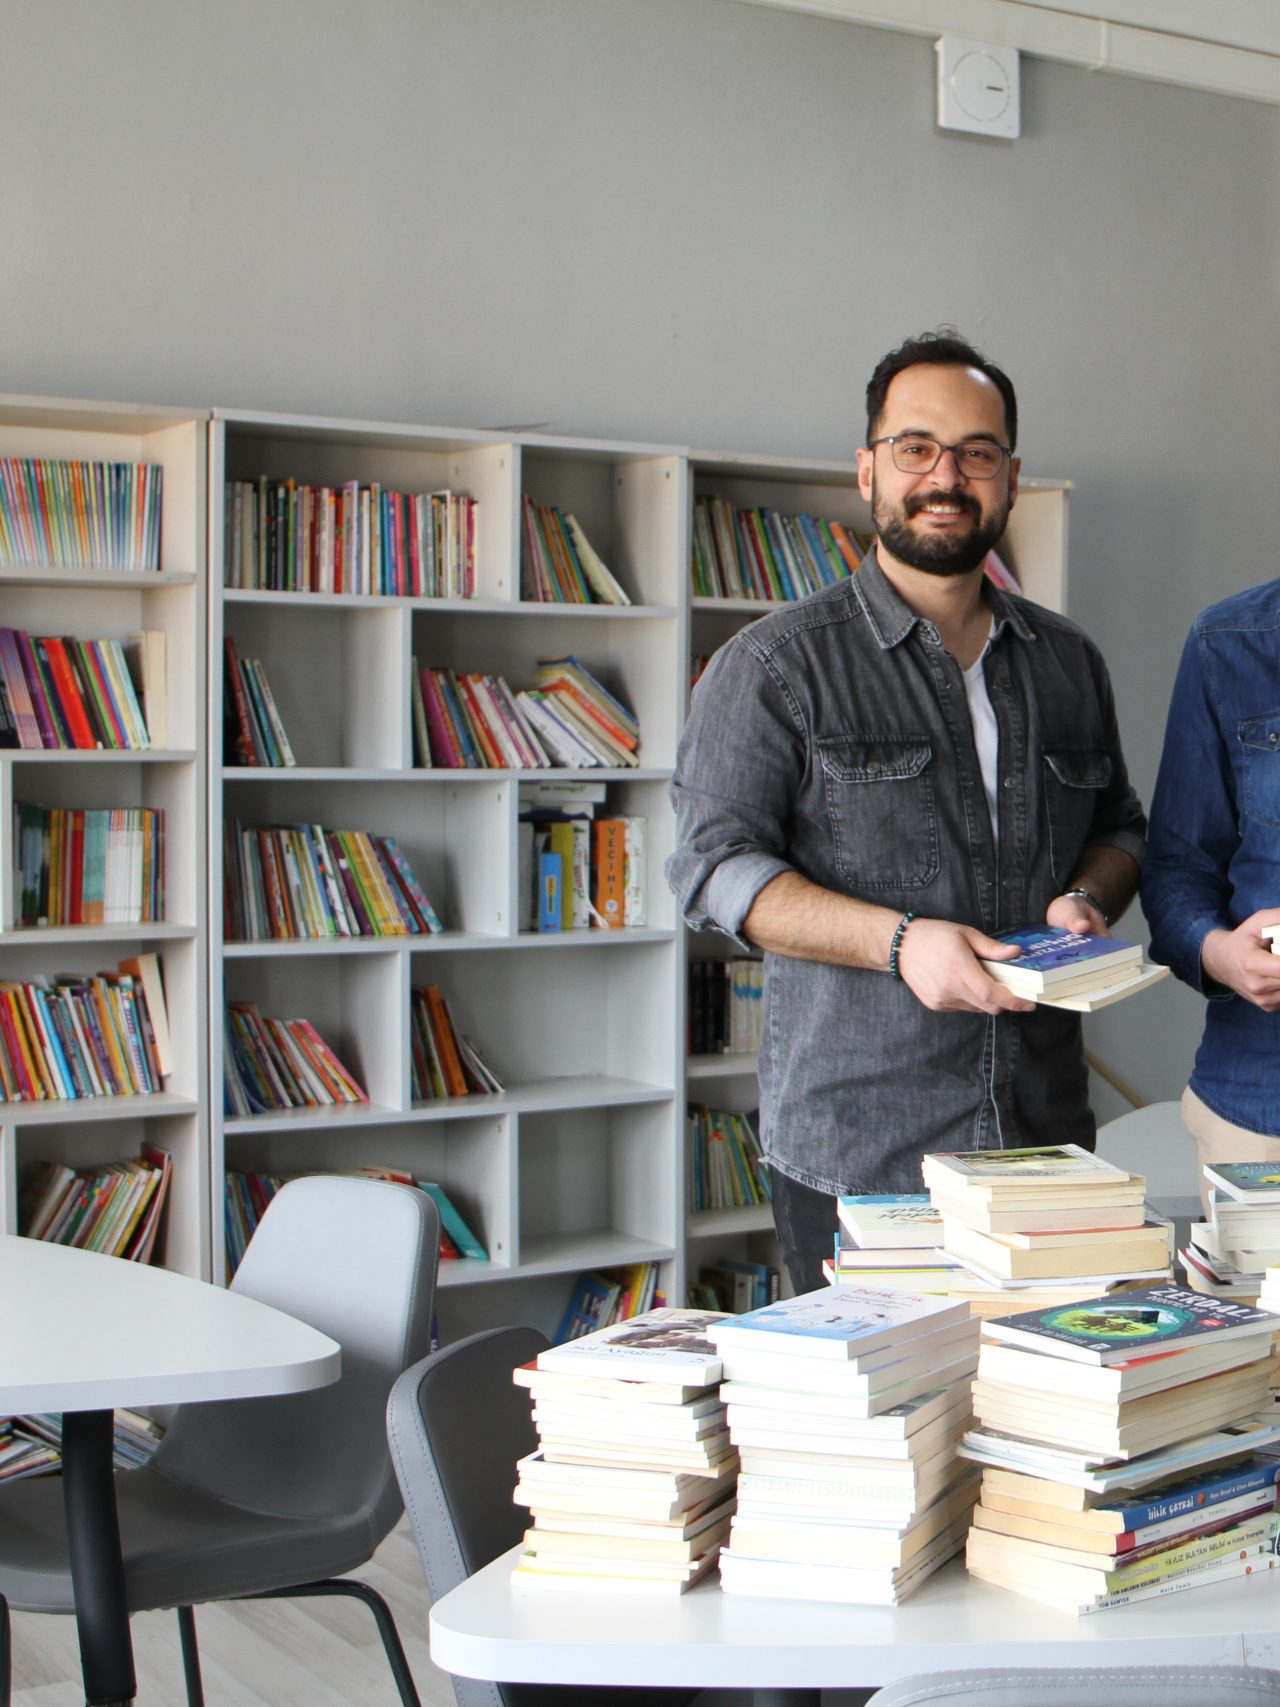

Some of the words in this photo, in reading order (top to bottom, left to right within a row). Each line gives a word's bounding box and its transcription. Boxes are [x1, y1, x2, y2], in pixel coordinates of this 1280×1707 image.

[1164, 1555, 1184, 1567] YAVUZ
[1185, 1546, 1208, 1561] SULTAN
[1209, 1539, 1226, 1552] SELİM
[1098, 1601, 1110, 1609] TOM
[1110, 1596, 1130, 1608] SAWYER
[1160, 1586, 1174, 1594] Mark
[1175, 1582, 1192, 1591] Twain
[1110, 1588, 1120, 1597] TOM
